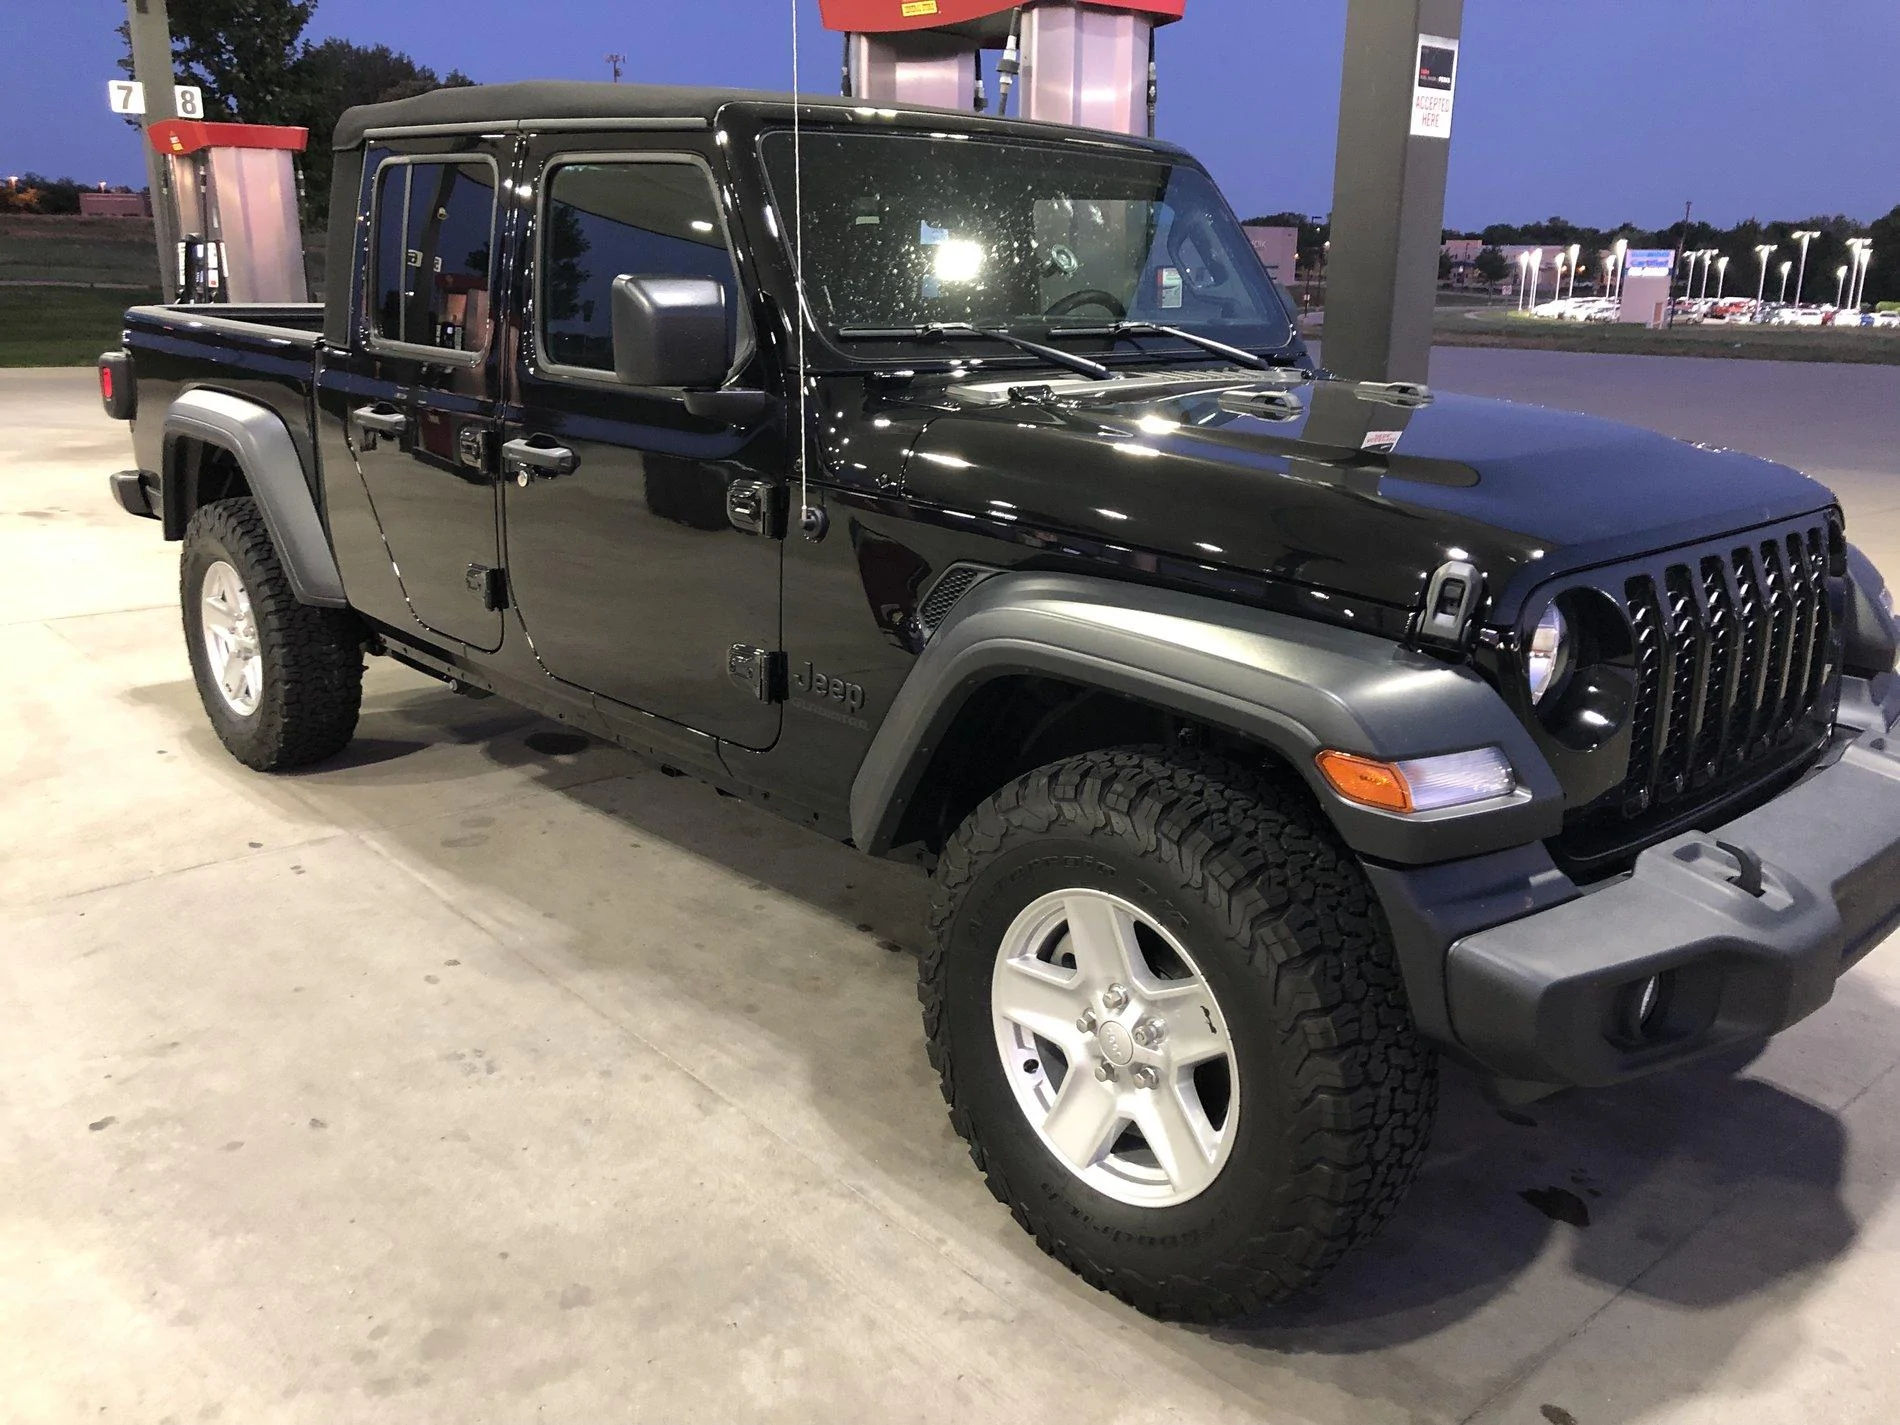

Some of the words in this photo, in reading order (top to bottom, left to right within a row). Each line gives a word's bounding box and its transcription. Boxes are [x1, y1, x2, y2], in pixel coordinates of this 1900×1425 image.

[117, 85, 133, 109] 7
[181, 90, 196, 115] 8
[1416, 95, 1450, 112] ACCEPTED
[1421, 112, 1440, 128] HERE
[792, 661, 865, 714] Jeep
